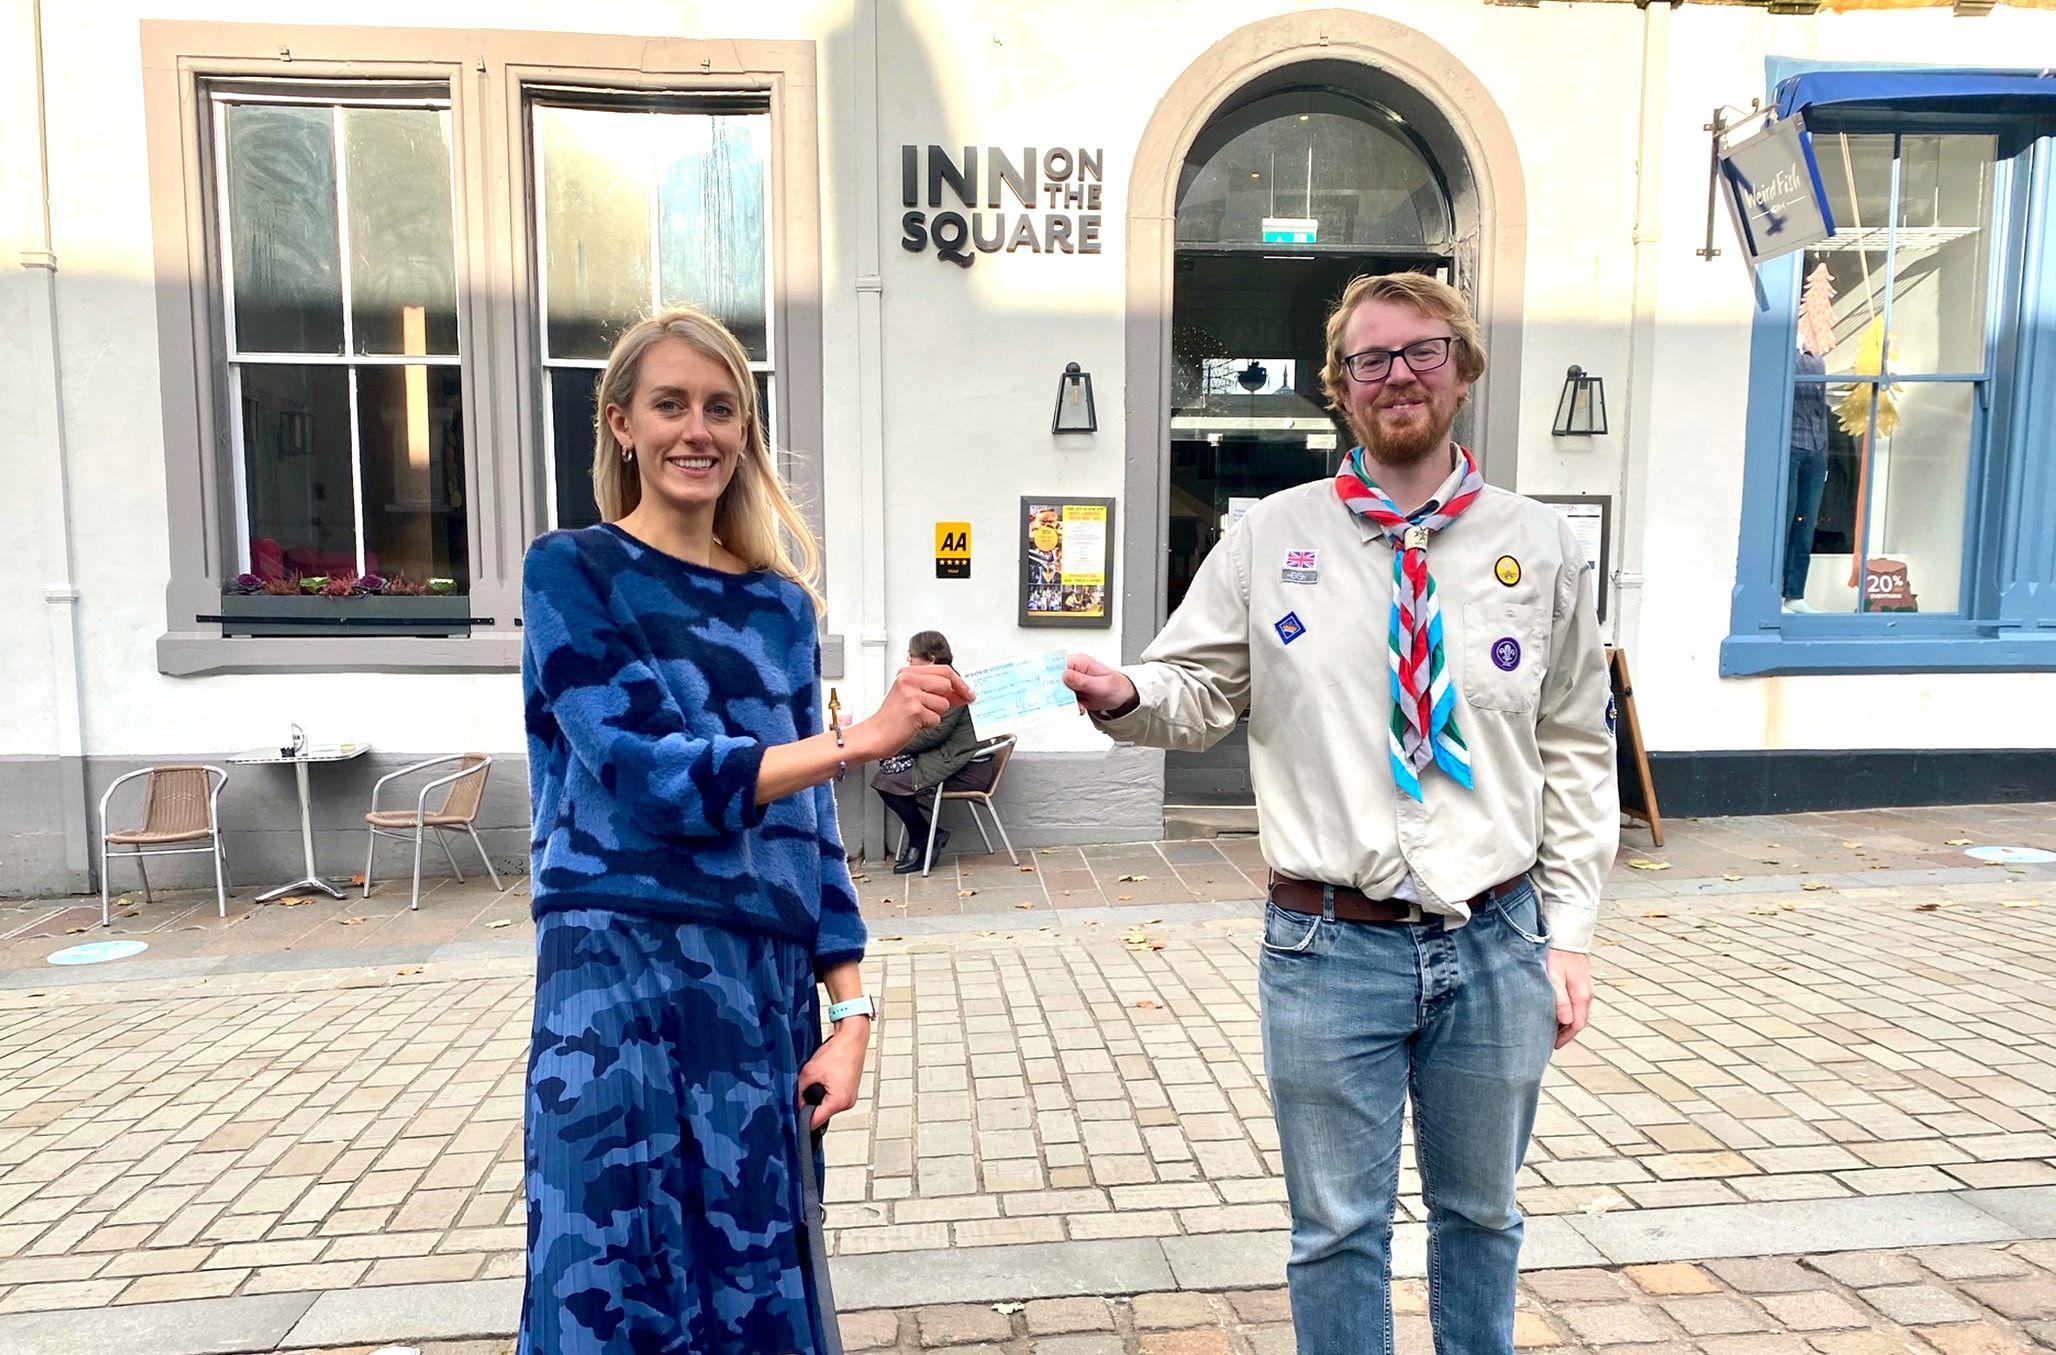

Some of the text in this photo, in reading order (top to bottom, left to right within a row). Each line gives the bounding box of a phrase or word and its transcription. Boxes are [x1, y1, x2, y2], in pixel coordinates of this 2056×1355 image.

[902, 145, 1103, 208] INN ON
[1744, 162, 1801, 208] Weird Fish
[1043, 183, 1102, 210] THE
[902, 211, 1102, 268] SQUARE
[940, 532, 967, 551] AA
[1866, 575, 1904, 592] 20%
